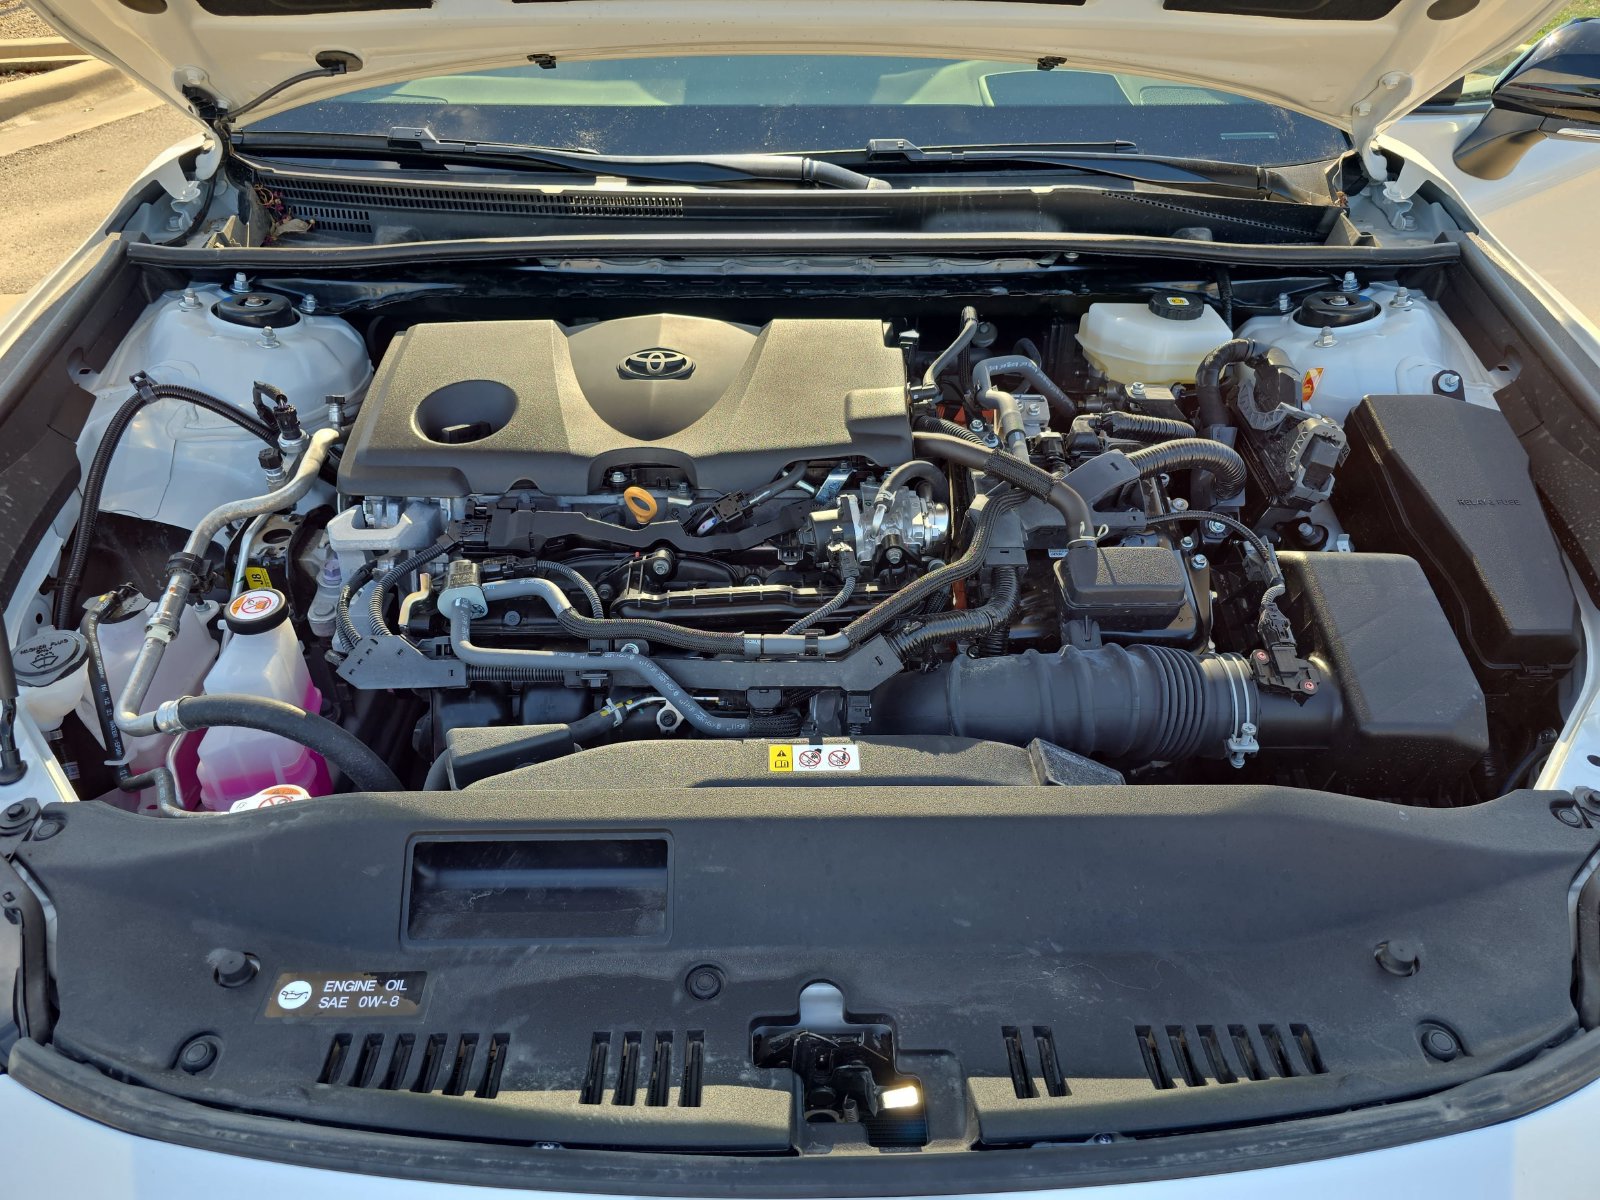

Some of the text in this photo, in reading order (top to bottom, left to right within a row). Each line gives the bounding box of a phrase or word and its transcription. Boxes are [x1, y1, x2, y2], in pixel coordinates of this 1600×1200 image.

[323, 979, 408, 992] ENGINE OIL
[318, 996, 400, 1009] SAE 0W-8
